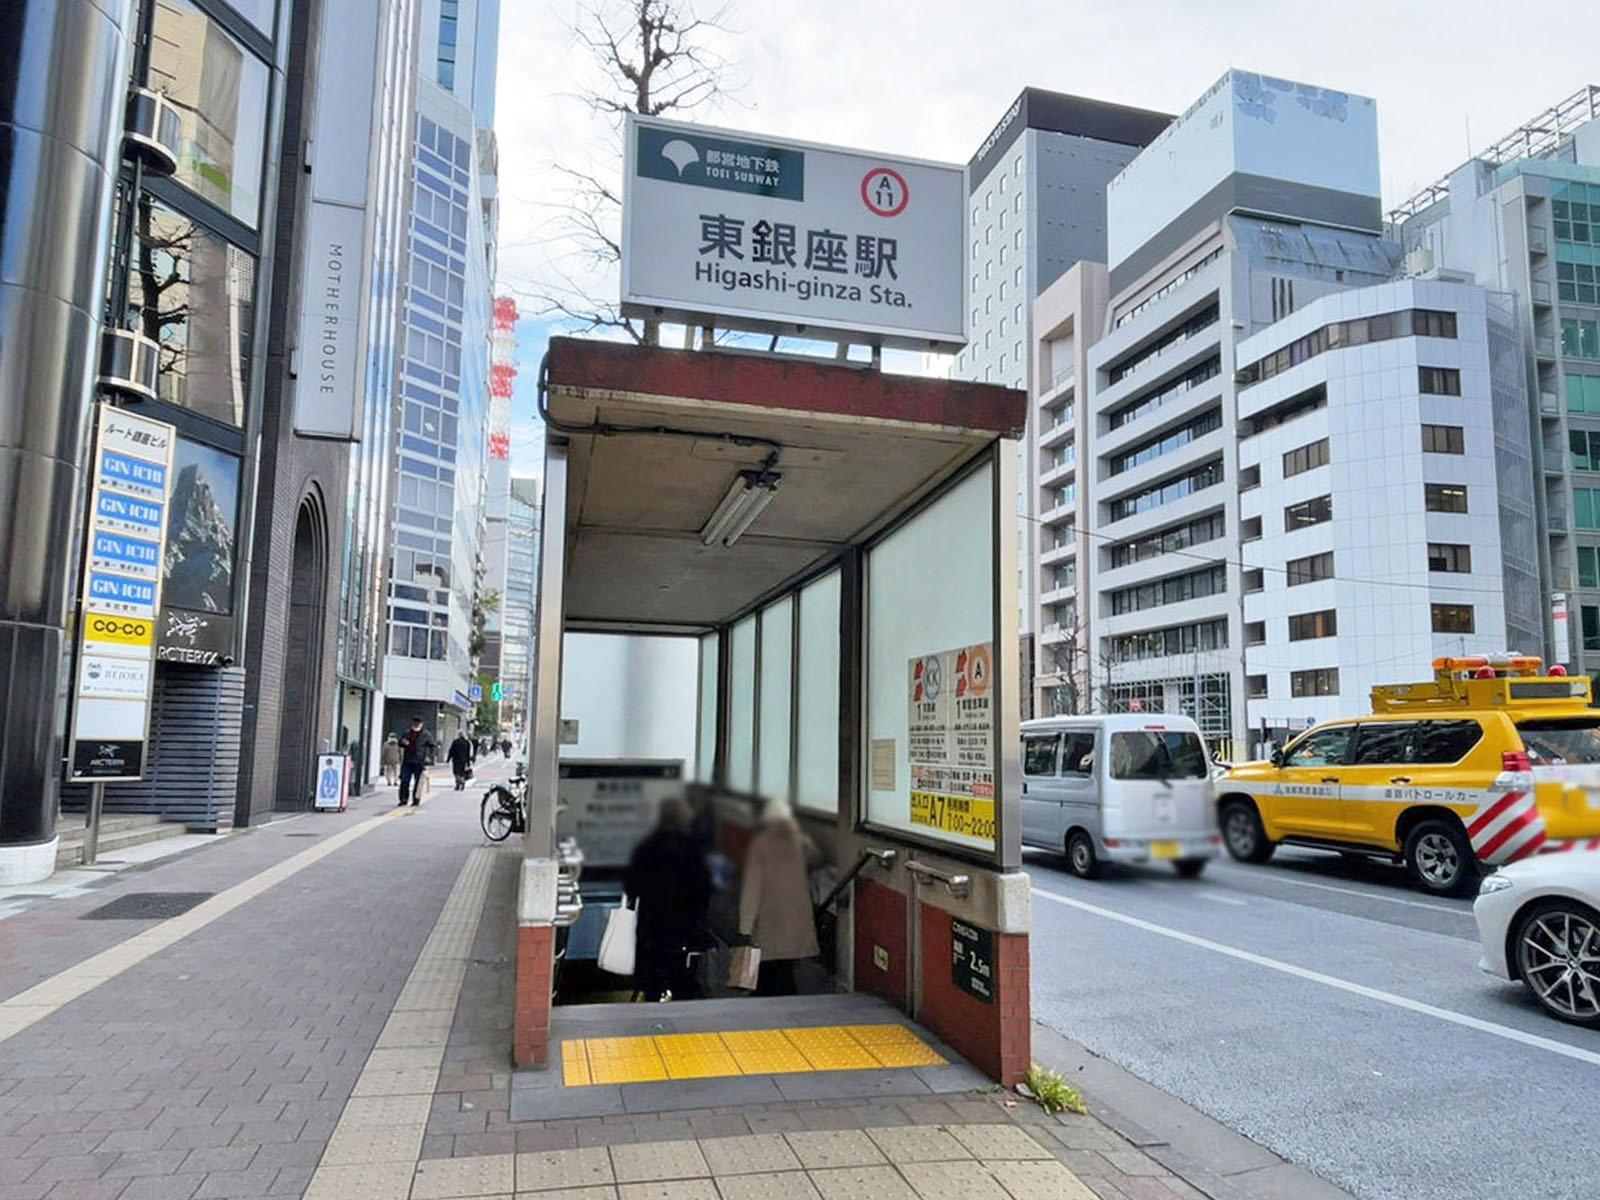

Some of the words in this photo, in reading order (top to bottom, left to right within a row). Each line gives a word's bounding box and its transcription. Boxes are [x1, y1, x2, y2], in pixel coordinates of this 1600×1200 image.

[706, 150, 780, 173] 都営地下鉄
[706, 166, 730, 179] TOEI
[734, 171, 780, 187] SUBWAY
[879, 176, 892, 190] A
[876, 190, 893, 207] 11
[698, 213, 898, 281] 東銀座駅
[696, 262, 861, 301] Higashi-ginza
[869, 284, 912, 308] Sta.
[320, 243, 343, 394] MOTHERHOUSE
[93, 619, 146, 637] CO-CO
[930, 795, 945, 828] A7
